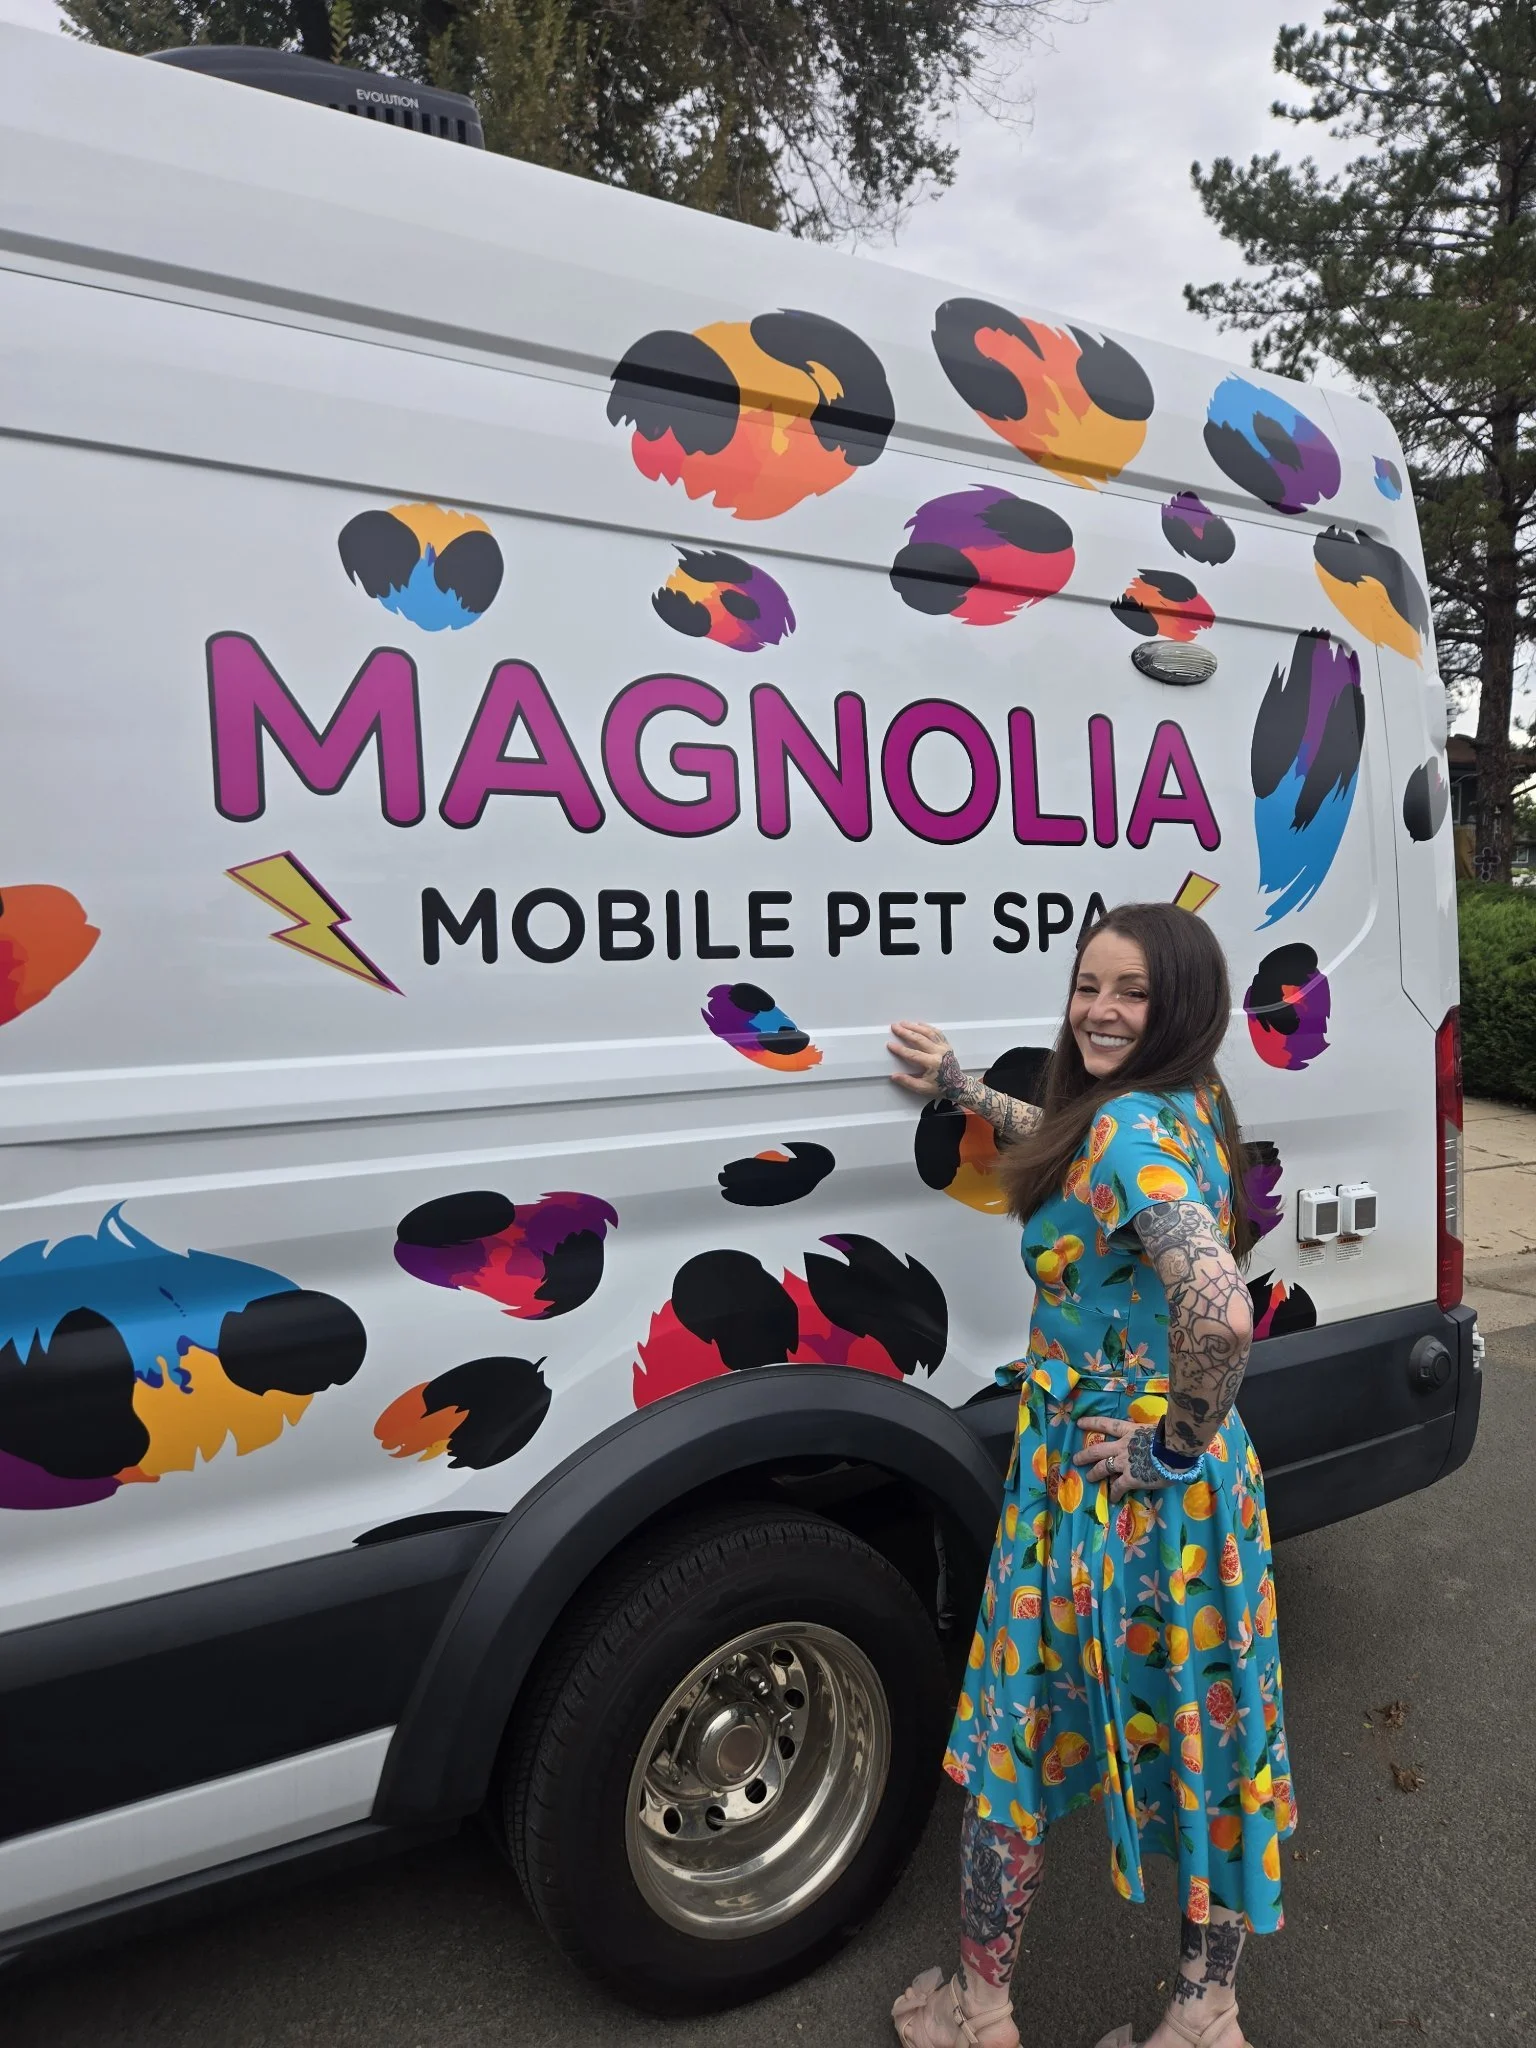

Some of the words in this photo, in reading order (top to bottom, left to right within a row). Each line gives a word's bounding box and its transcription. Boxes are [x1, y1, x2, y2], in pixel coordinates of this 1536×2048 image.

[356, 88, 419, 109] EVOLUTION
[206, 630, 1221, 852] MAGNOLIA
[422, 887, 794, 965] MOBILE
[827, 891, 967, 957] PET
[992, 891, 1108, 954] SPA
